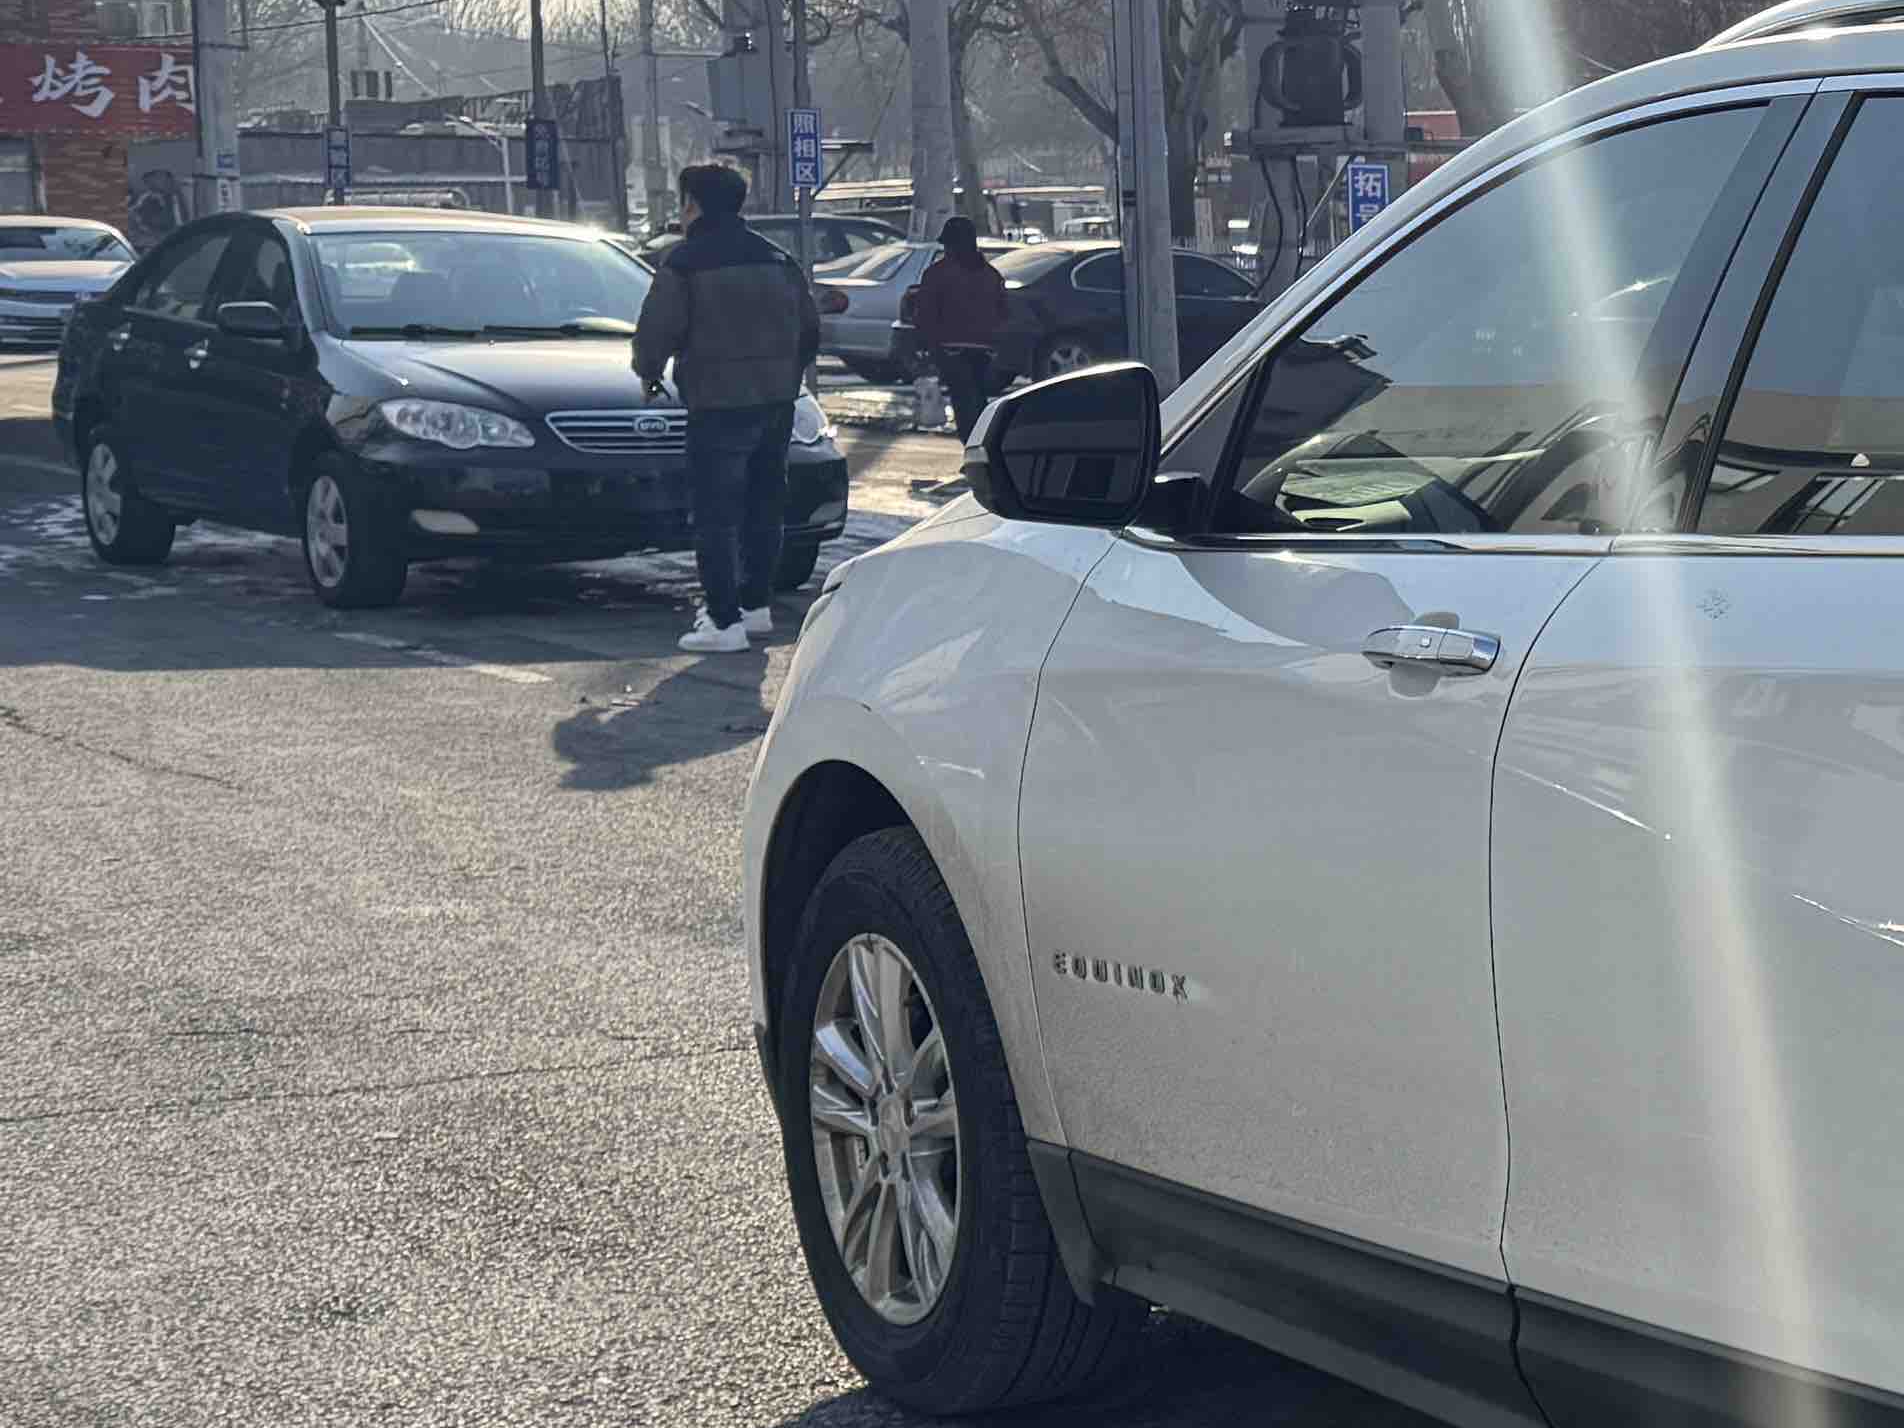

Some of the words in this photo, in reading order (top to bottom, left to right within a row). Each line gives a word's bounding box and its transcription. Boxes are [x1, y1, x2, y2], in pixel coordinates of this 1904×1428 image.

[29, 51, 196, 118] 烤肉
[791, 111, 818, 183] 照相区
[1052, 950, 1190, 1002] EQUINOX
